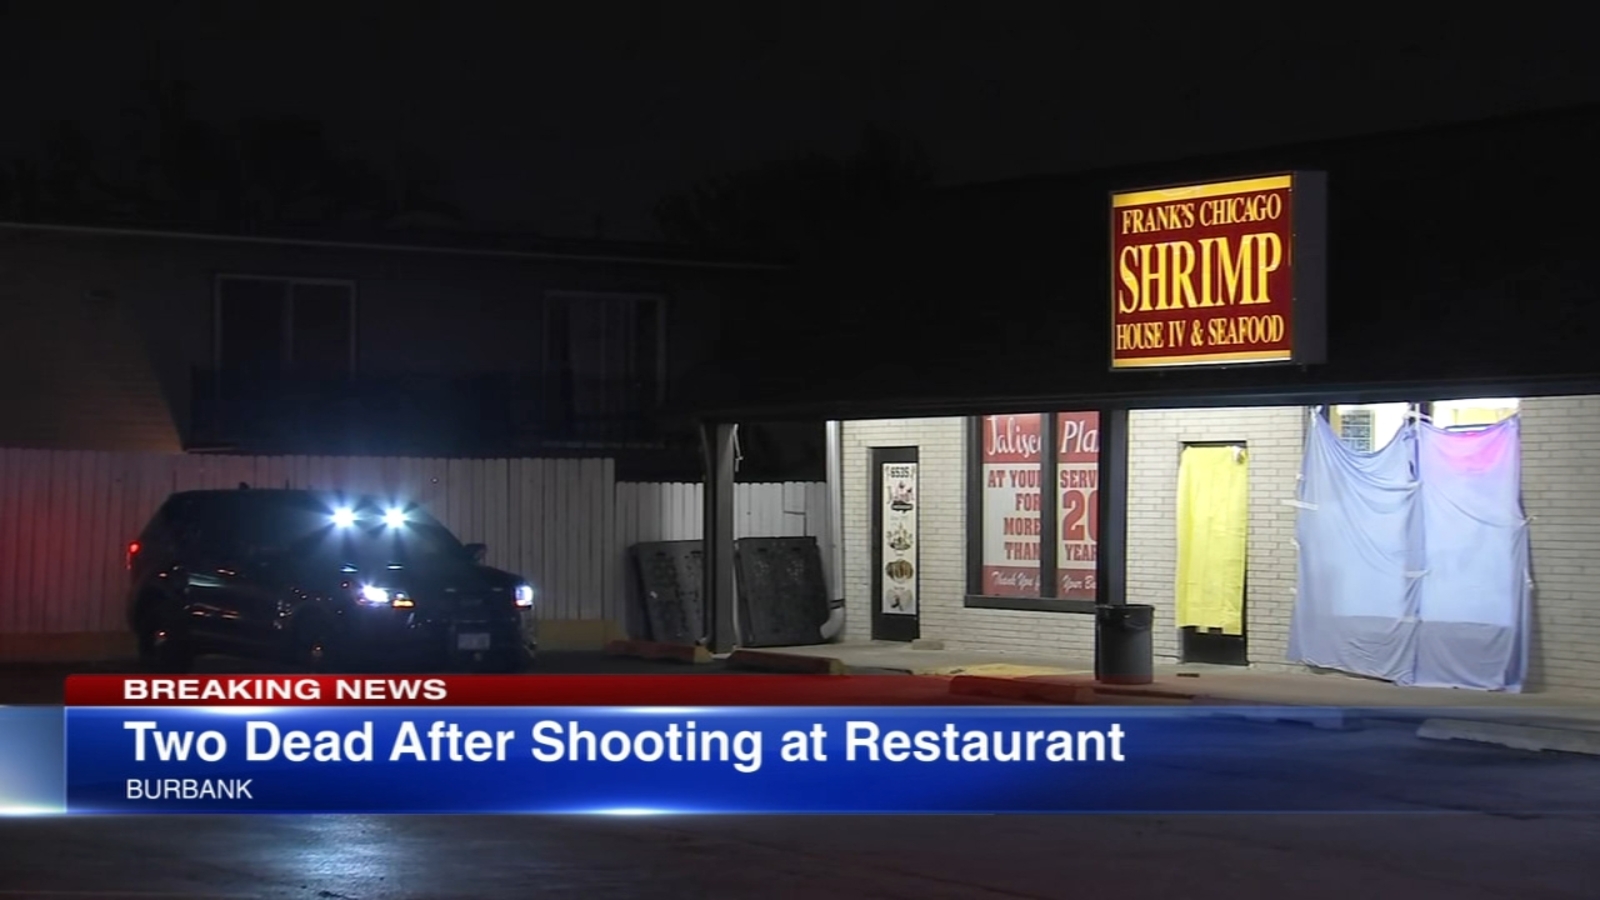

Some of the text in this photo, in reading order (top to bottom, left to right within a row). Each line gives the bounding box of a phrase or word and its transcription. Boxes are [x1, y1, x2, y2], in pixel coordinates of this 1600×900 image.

[1121, 193, 1281, 234] FRANK'S CHICAGO
[1118, 231, 1282, 314] SHRIMP
[1116, 314, 1285, 350] HOUSE IV & SEAFOOD
[987, 469, 1006, 488] AT
[1004, 517, 1041, 536] MORE
